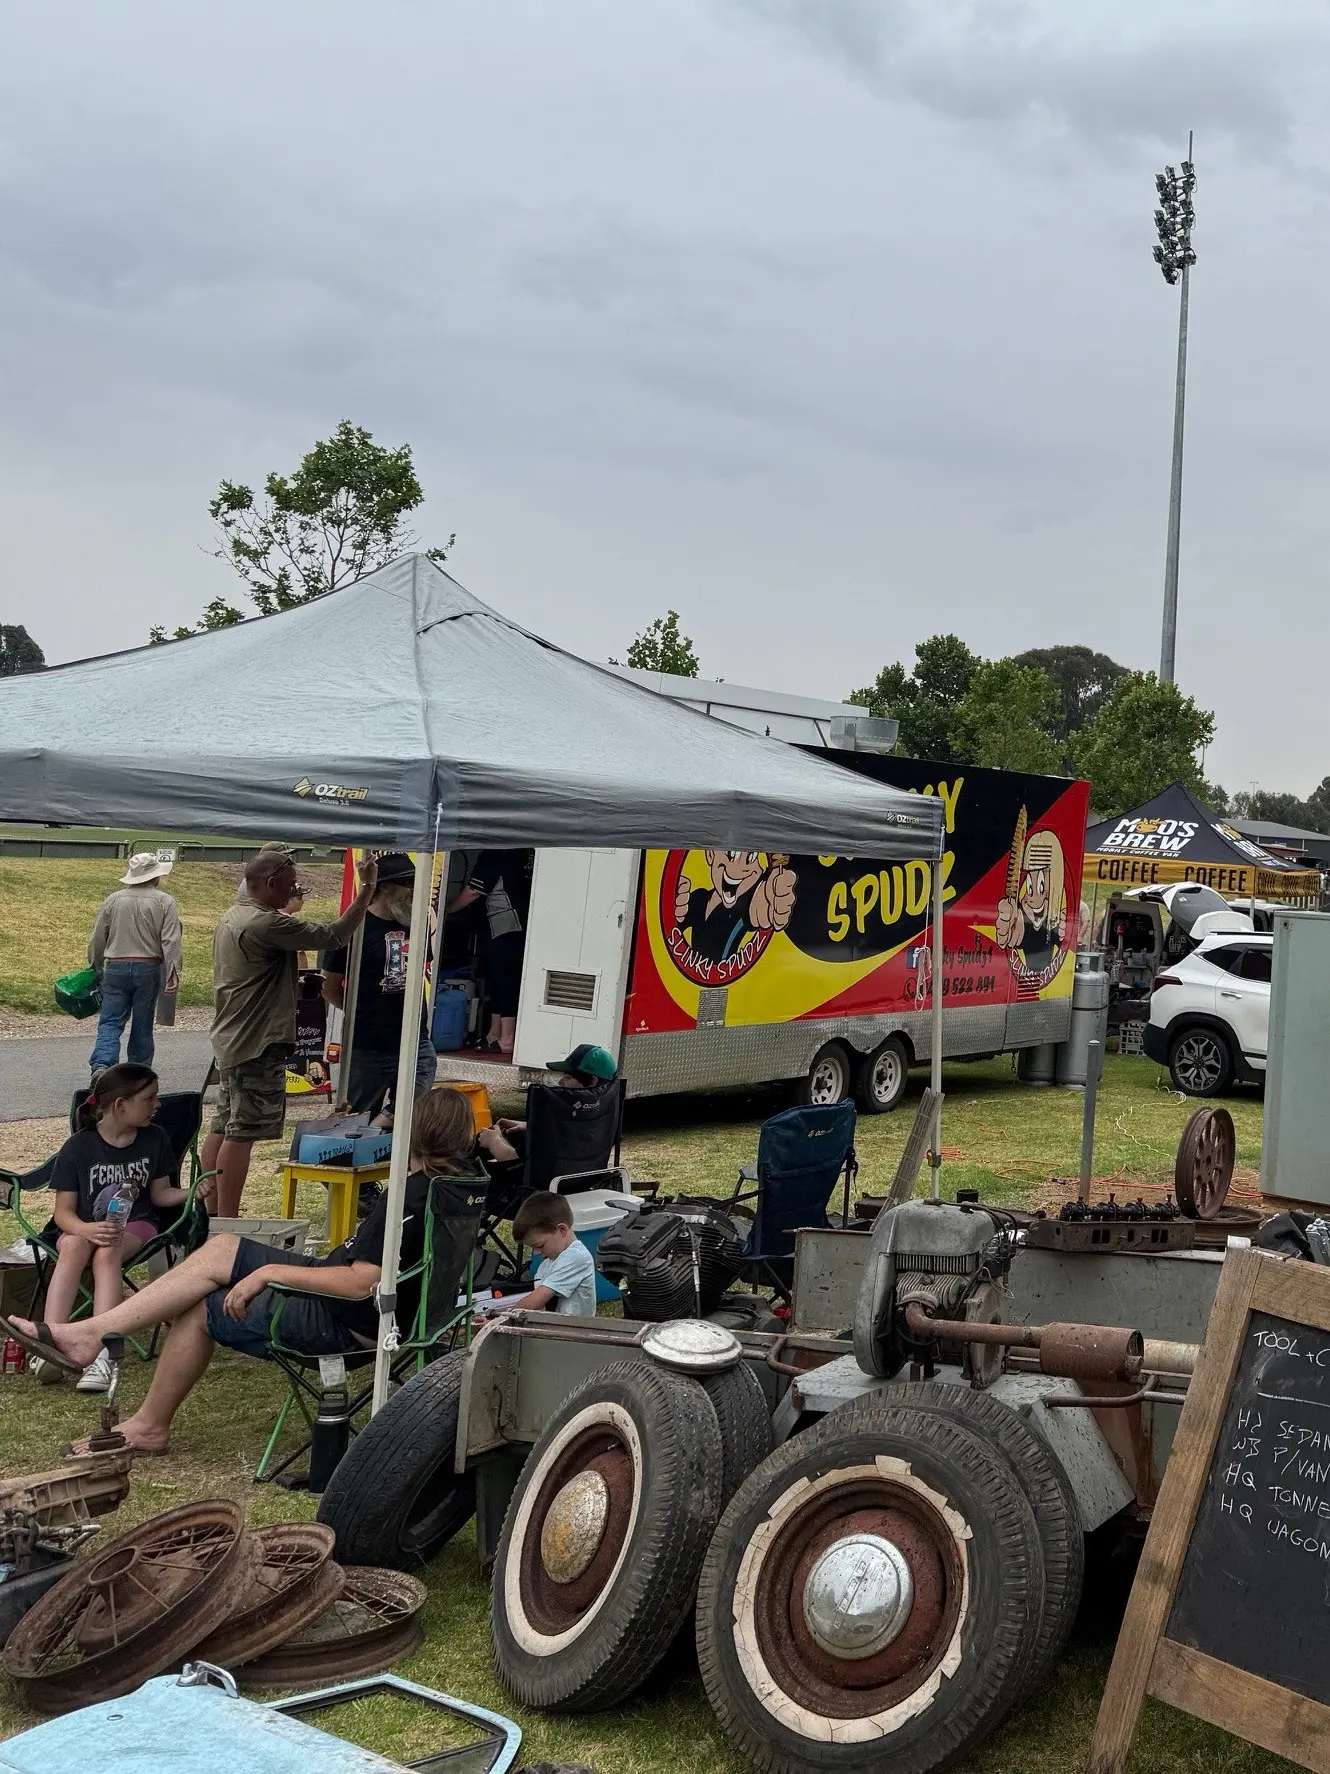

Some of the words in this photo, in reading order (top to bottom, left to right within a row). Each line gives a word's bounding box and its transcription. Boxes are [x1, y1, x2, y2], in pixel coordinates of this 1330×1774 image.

[1102, 832, 1191, 851] BREW
[1097, 858, 1160, 885] COFFEE
[1184, 866, 1248, 892] COFFEE
[667, 926, 714, 980] SLINKY
[717, 931, 767, 980] SPUDZ
[90, 1158, 149, 1195] FEARLESS
[1253, 1331, 1300, 1356] TOOL
[1225, 1462, 1257, 1492] HQ
[1220, 1493, 1252, 1524] HQ
